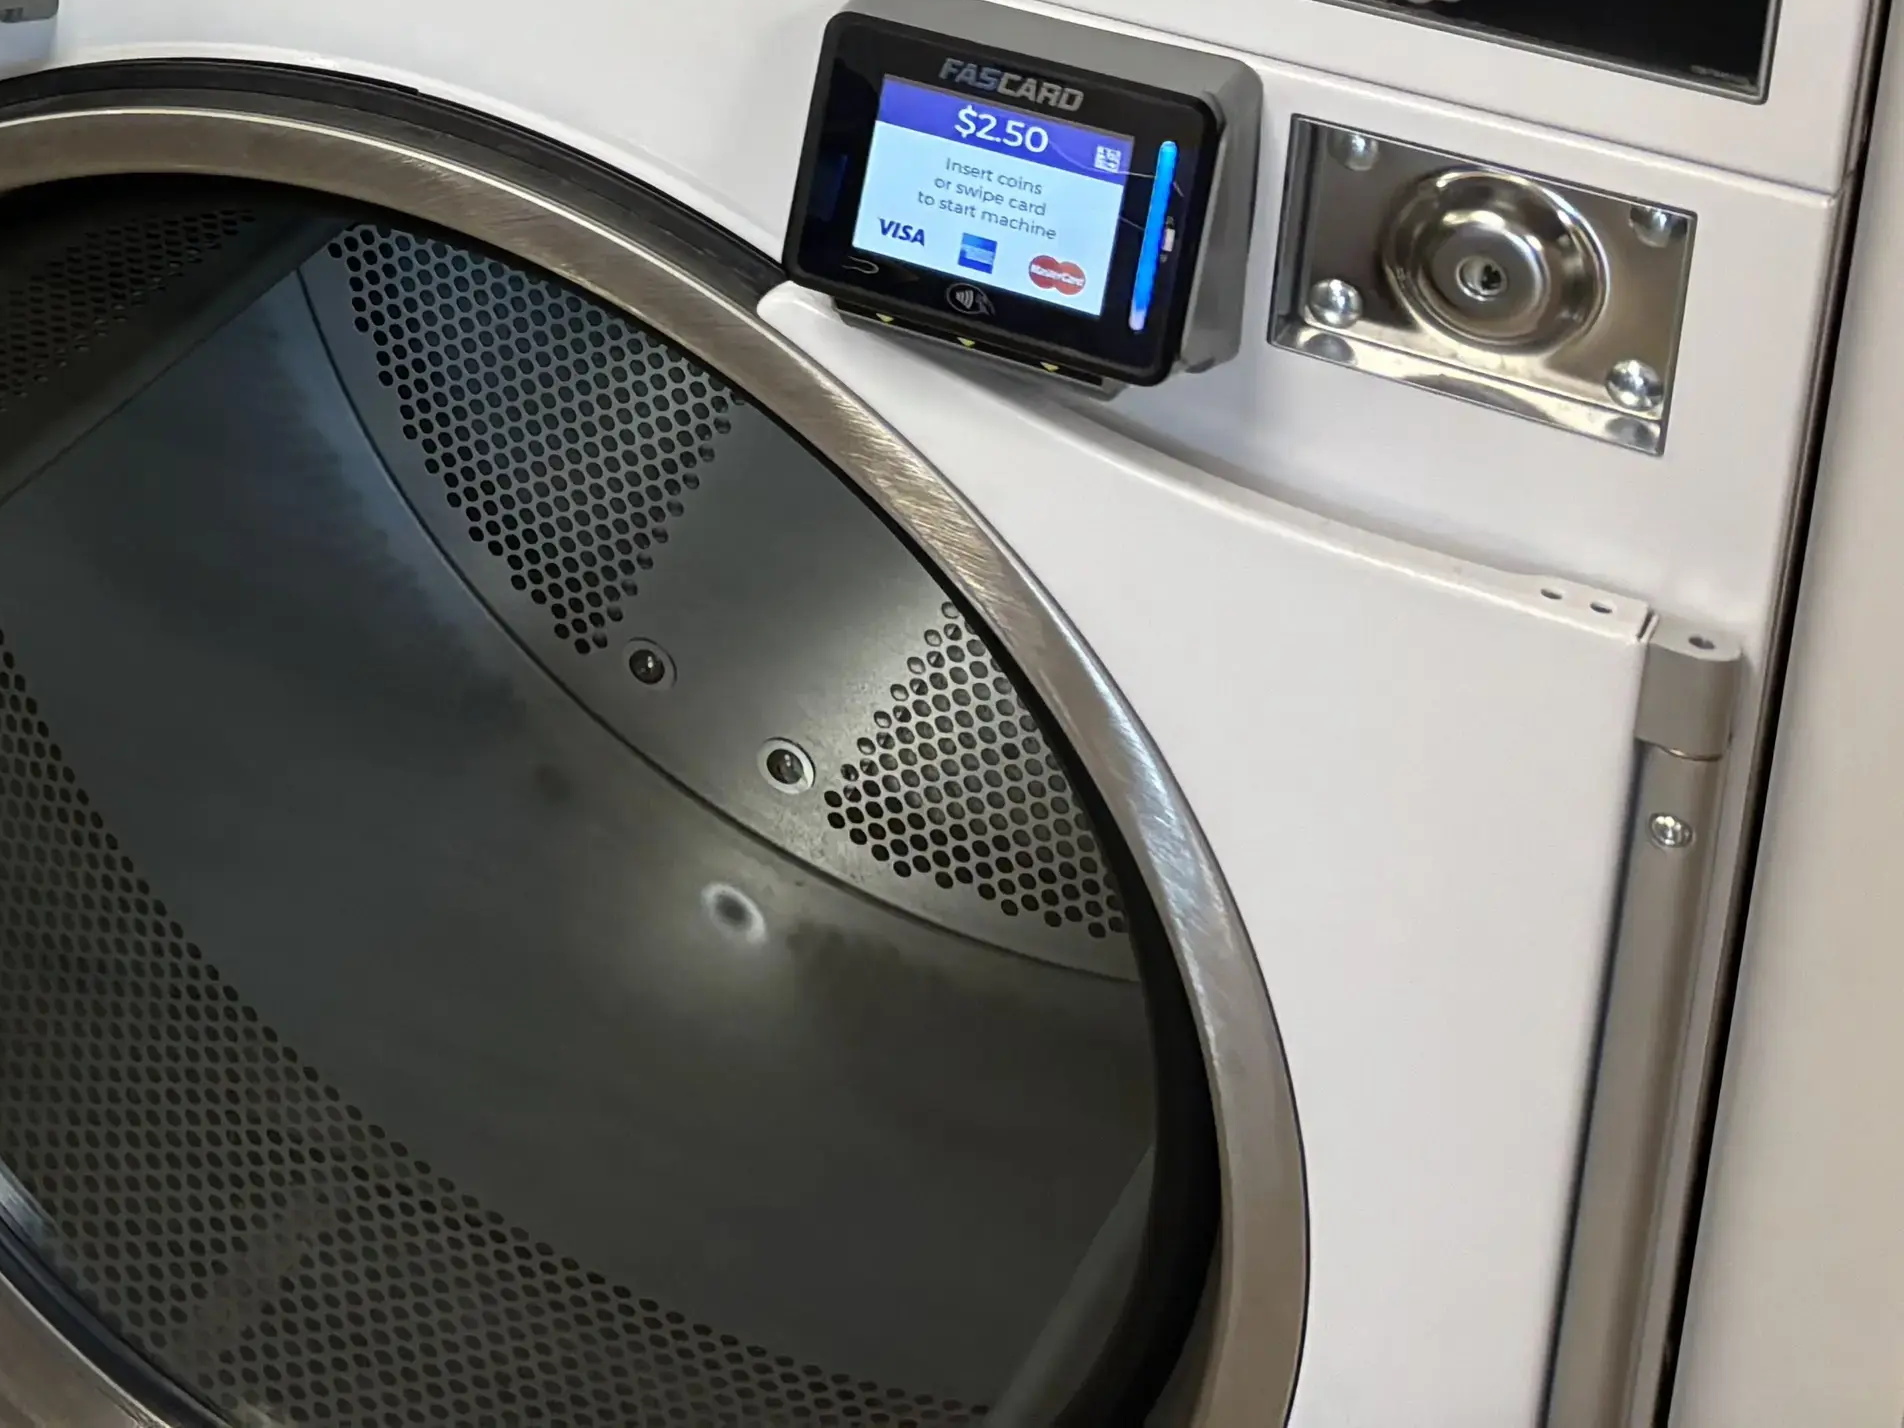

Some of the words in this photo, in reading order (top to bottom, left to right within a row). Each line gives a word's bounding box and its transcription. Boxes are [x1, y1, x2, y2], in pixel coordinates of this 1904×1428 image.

[938, 57, 1085, 113] FASCARD
[953, 104, 1050, 154] $2.50
[933, 176, 951, 191] or
[955, 180, 1005, 208] swipe
[1008, 194, 1047, 218] card
[945, 157, 994, 184] Insert
[997, 171, 1044, 196] coins
[878, 217, 926, 248] VISA
[917, 191, 935, 208] to
[938, 196, 977, 219] start
[980, 208, 1057, 241] machine
[1030, 262, 1085, 288] MasterCard
